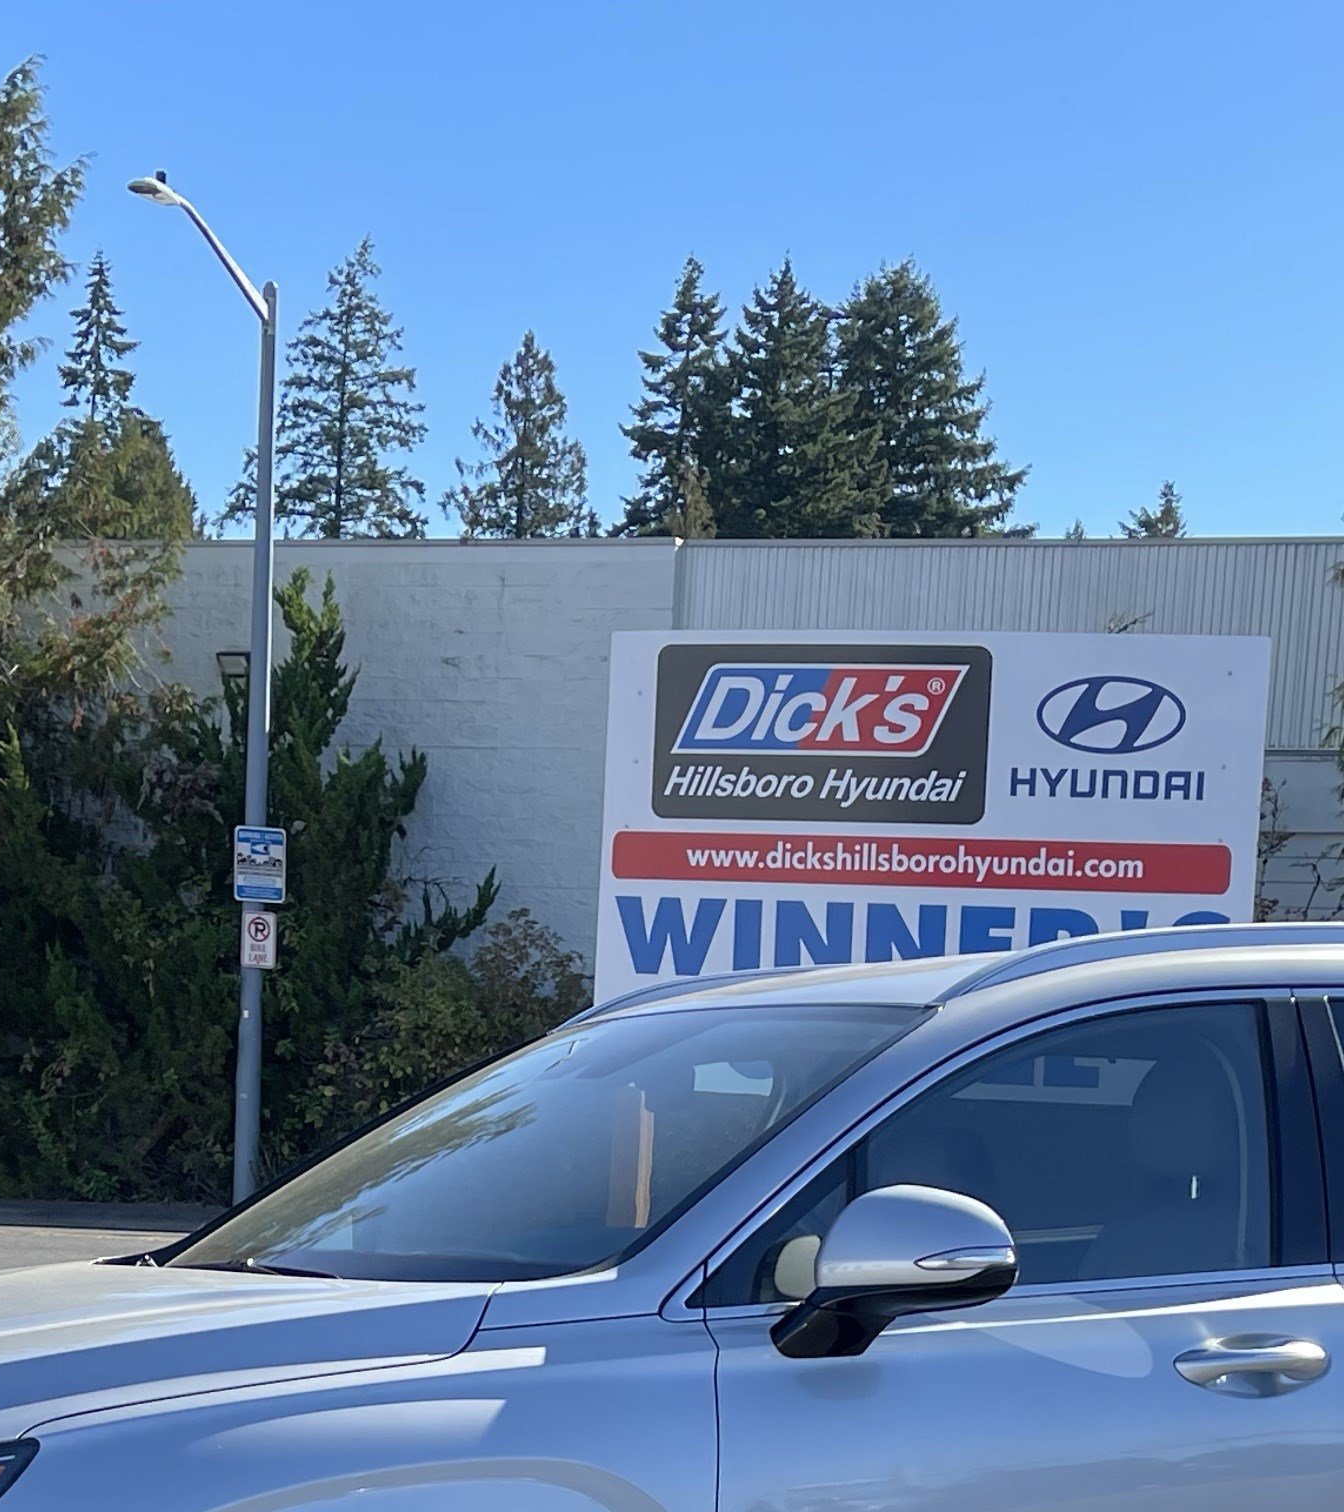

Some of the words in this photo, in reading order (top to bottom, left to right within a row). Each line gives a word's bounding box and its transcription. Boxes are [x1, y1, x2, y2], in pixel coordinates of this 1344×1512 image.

[694, 674, 930, 745] Dick's
[663, 765, 815, 798] Hillsboro
[819, 769, 967, 808] Hyundai
[1009, 767, 1205, 801] HYUNDAI
[686, 841, 1144, 881] www.dickshillsborohyundai.com
[615, 895, 1232, 977] WINNE'
